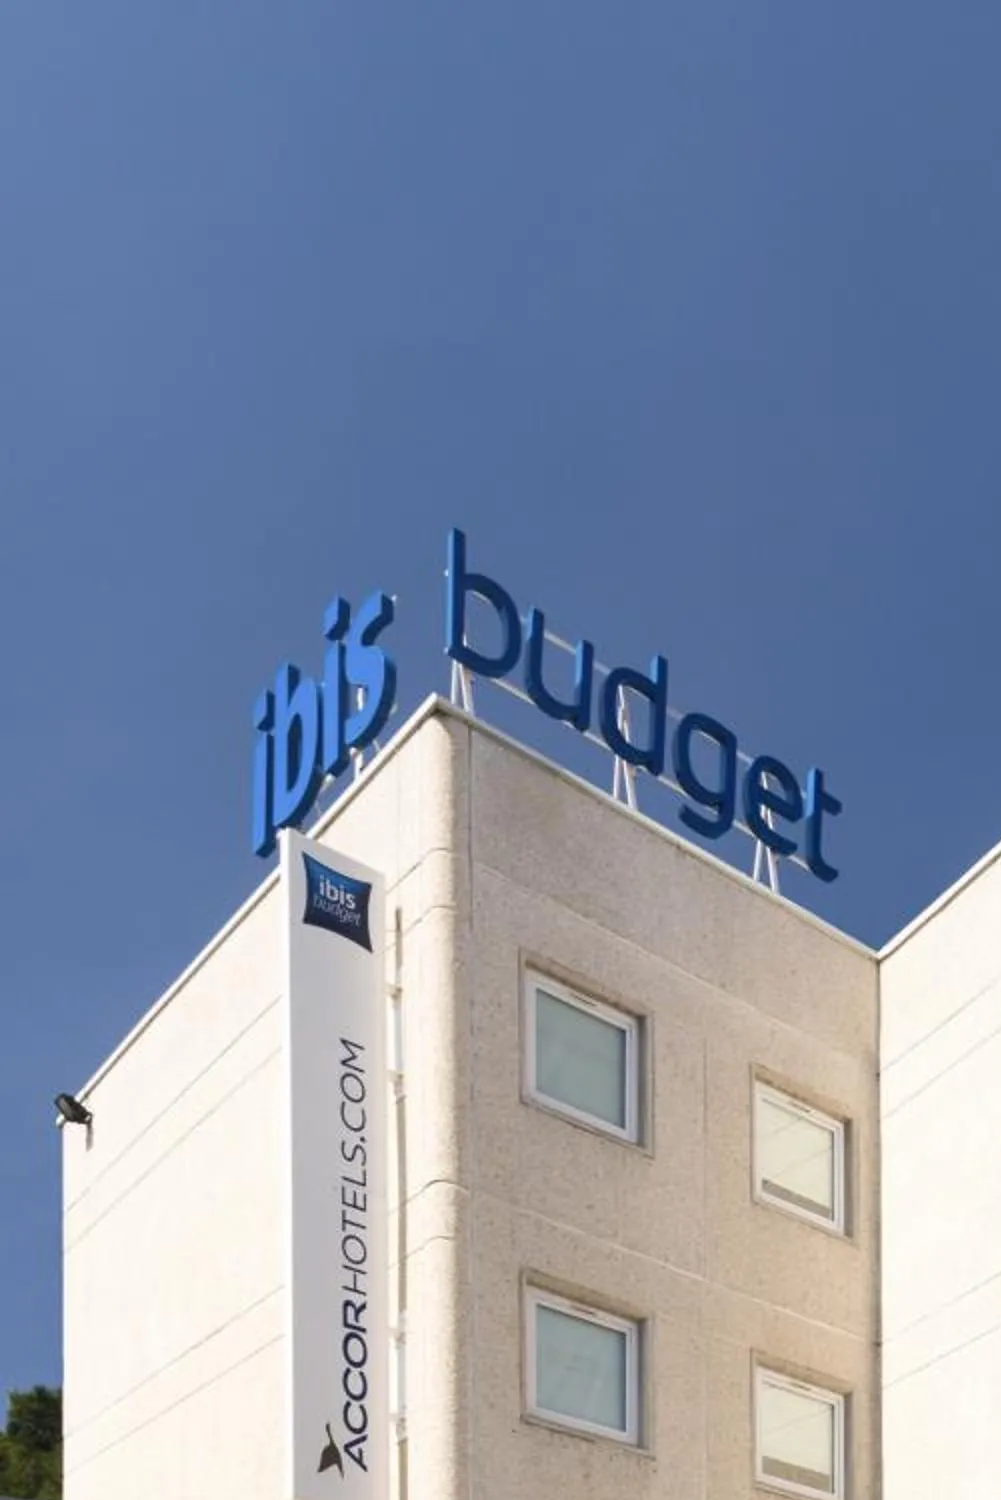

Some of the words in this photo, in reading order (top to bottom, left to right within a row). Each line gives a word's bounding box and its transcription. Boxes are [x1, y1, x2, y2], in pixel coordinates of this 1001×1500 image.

[252, 591, 396, 857] ibis
[447, 528, 842, 882] budget
[319, 874, 357, 909] ibis
[340, 1037, 368, 1473] ACCORHOTELS.COM
